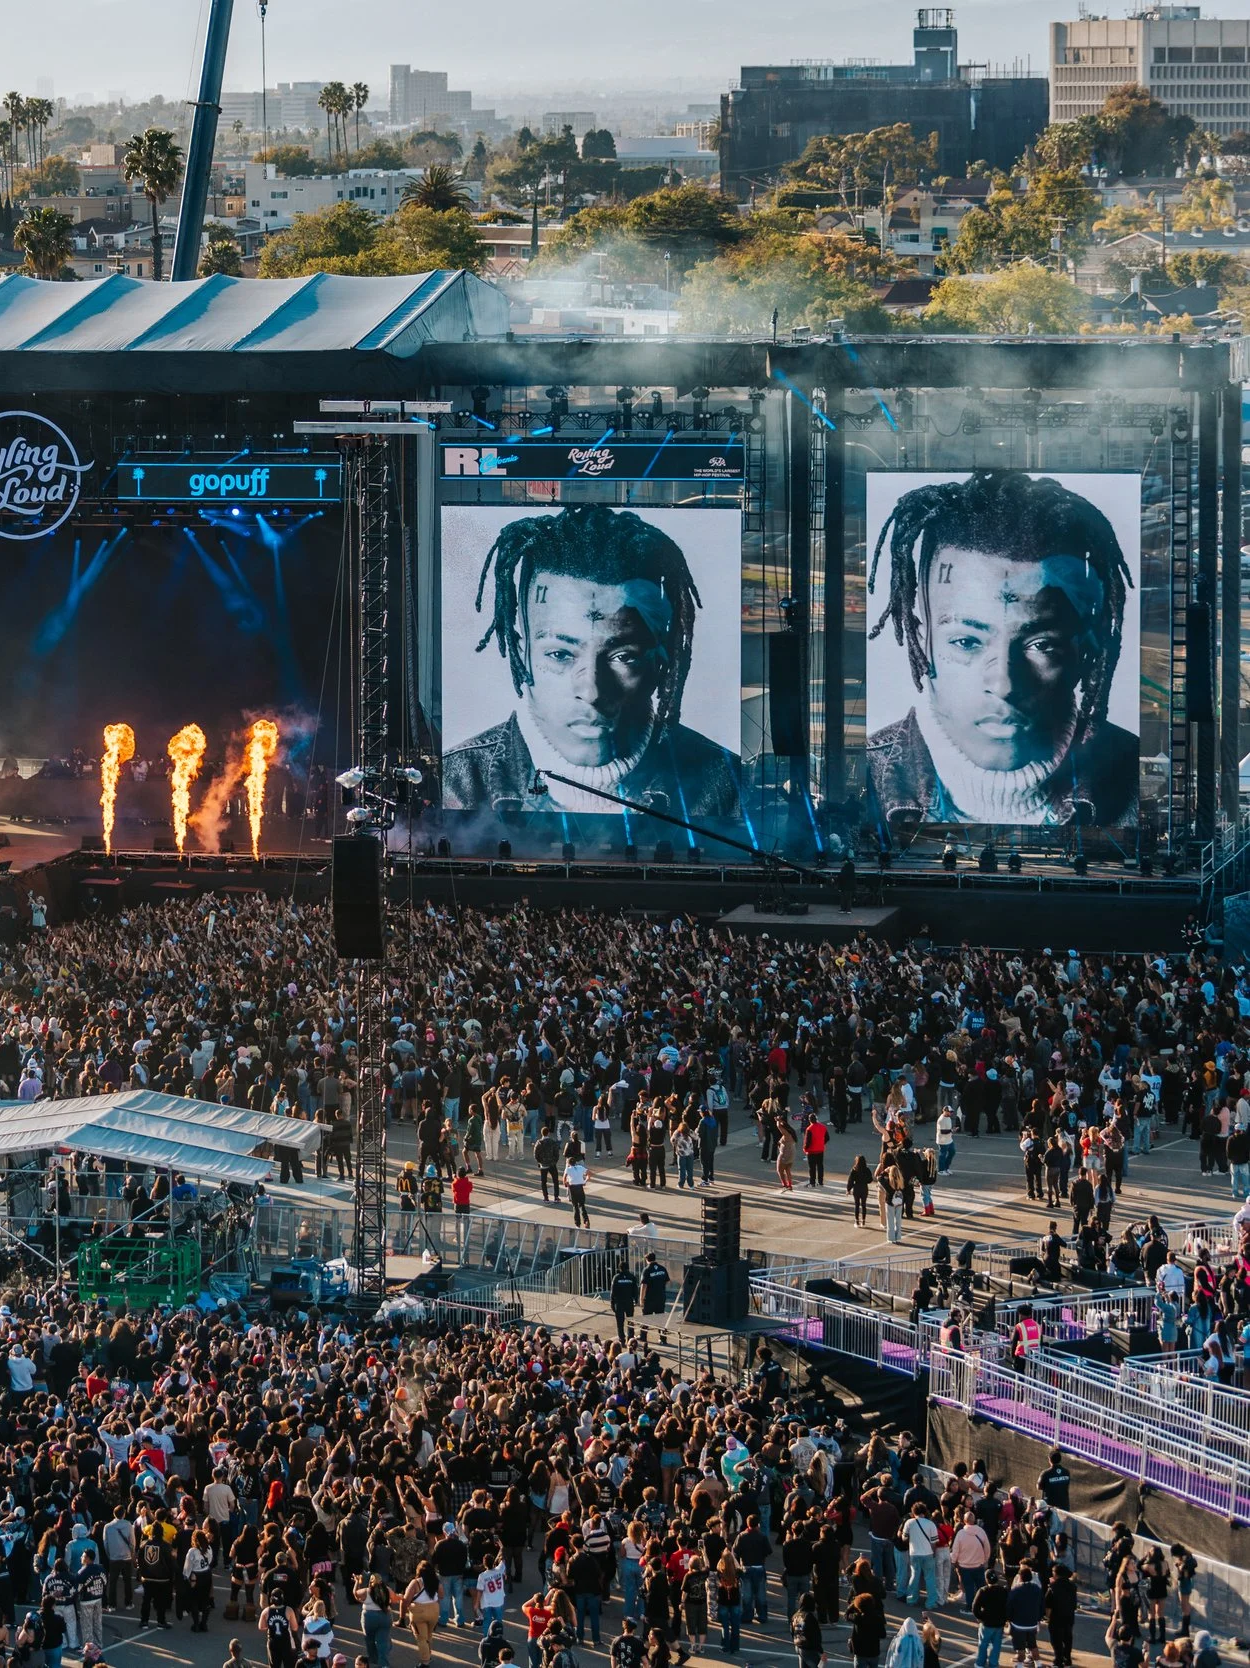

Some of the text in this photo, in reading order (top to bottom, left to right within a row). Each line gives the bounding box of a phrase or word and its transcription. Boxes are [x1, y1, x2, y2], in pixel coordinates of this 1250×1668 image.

[445, 448, 507, 475] RL
[568, 448, 613, 464] Rolling
[578, 459, 615, 475] Loud
[189, 468, 270, 496] gopuff
[487, 1578, 502, 1593] 85
[275, 1622, 281, 1635] 1
